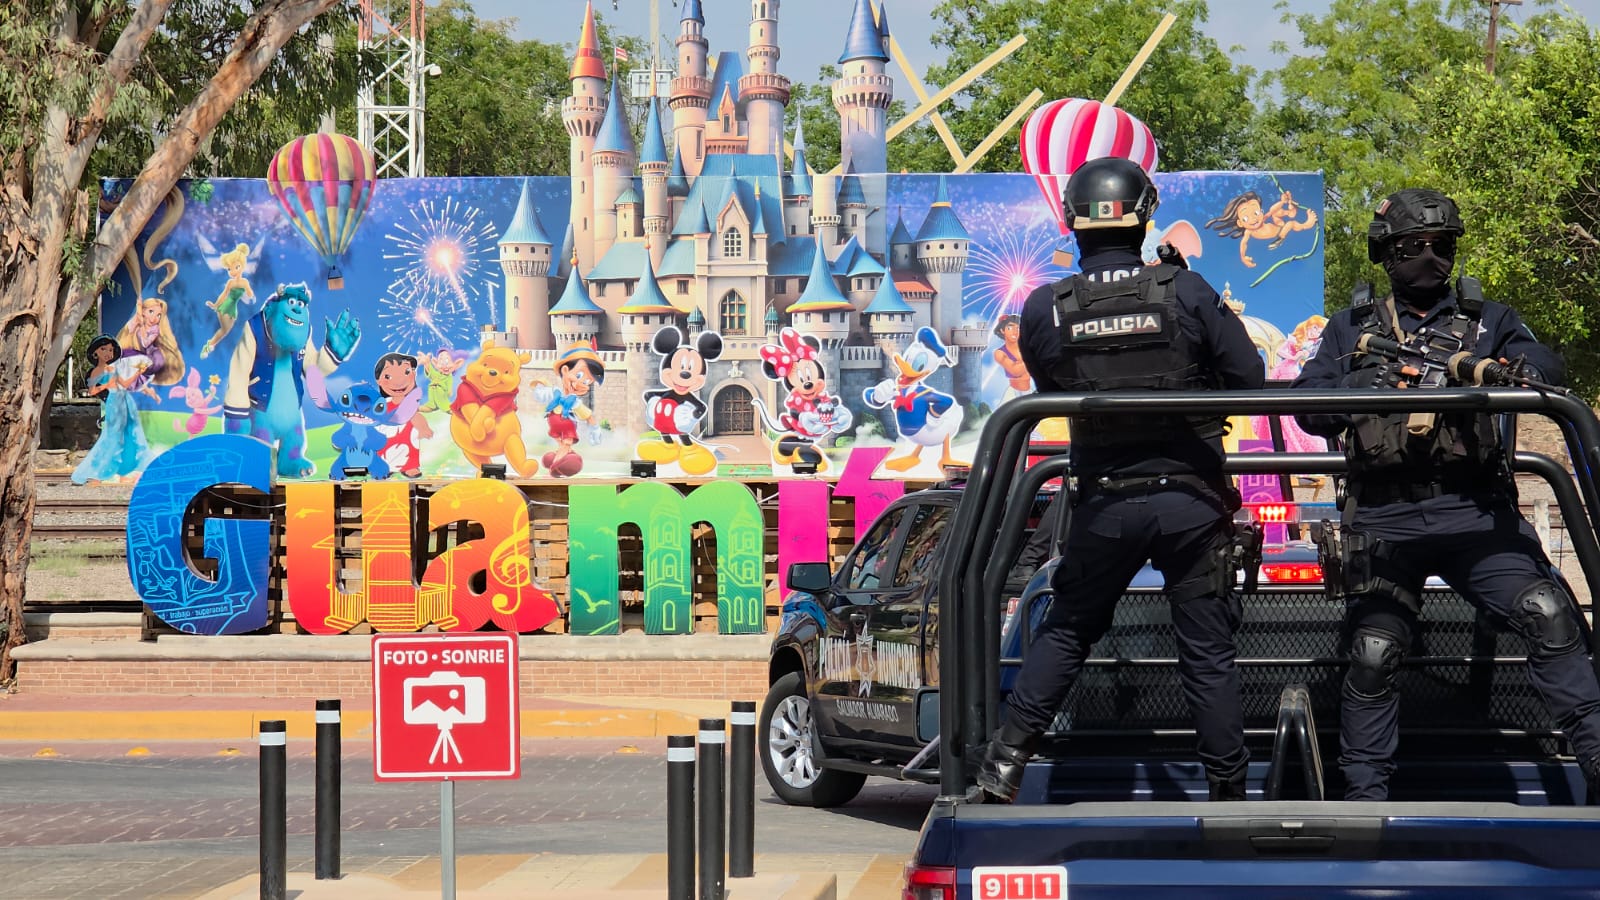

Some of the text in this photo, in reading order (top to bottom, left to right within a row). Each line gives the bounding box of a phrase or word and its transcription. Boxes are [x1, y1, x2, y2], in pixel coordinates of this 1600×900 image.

[1071, 315, 1158, 337] POLICIA
[383, 649, 505, 665] FOTO SONRIE
[877, 640, 921, 690] MUNICIPAL
[836, 699, 899, 722] SALVADOR ALVARADO
[985, 876, 1052, 897] 911
